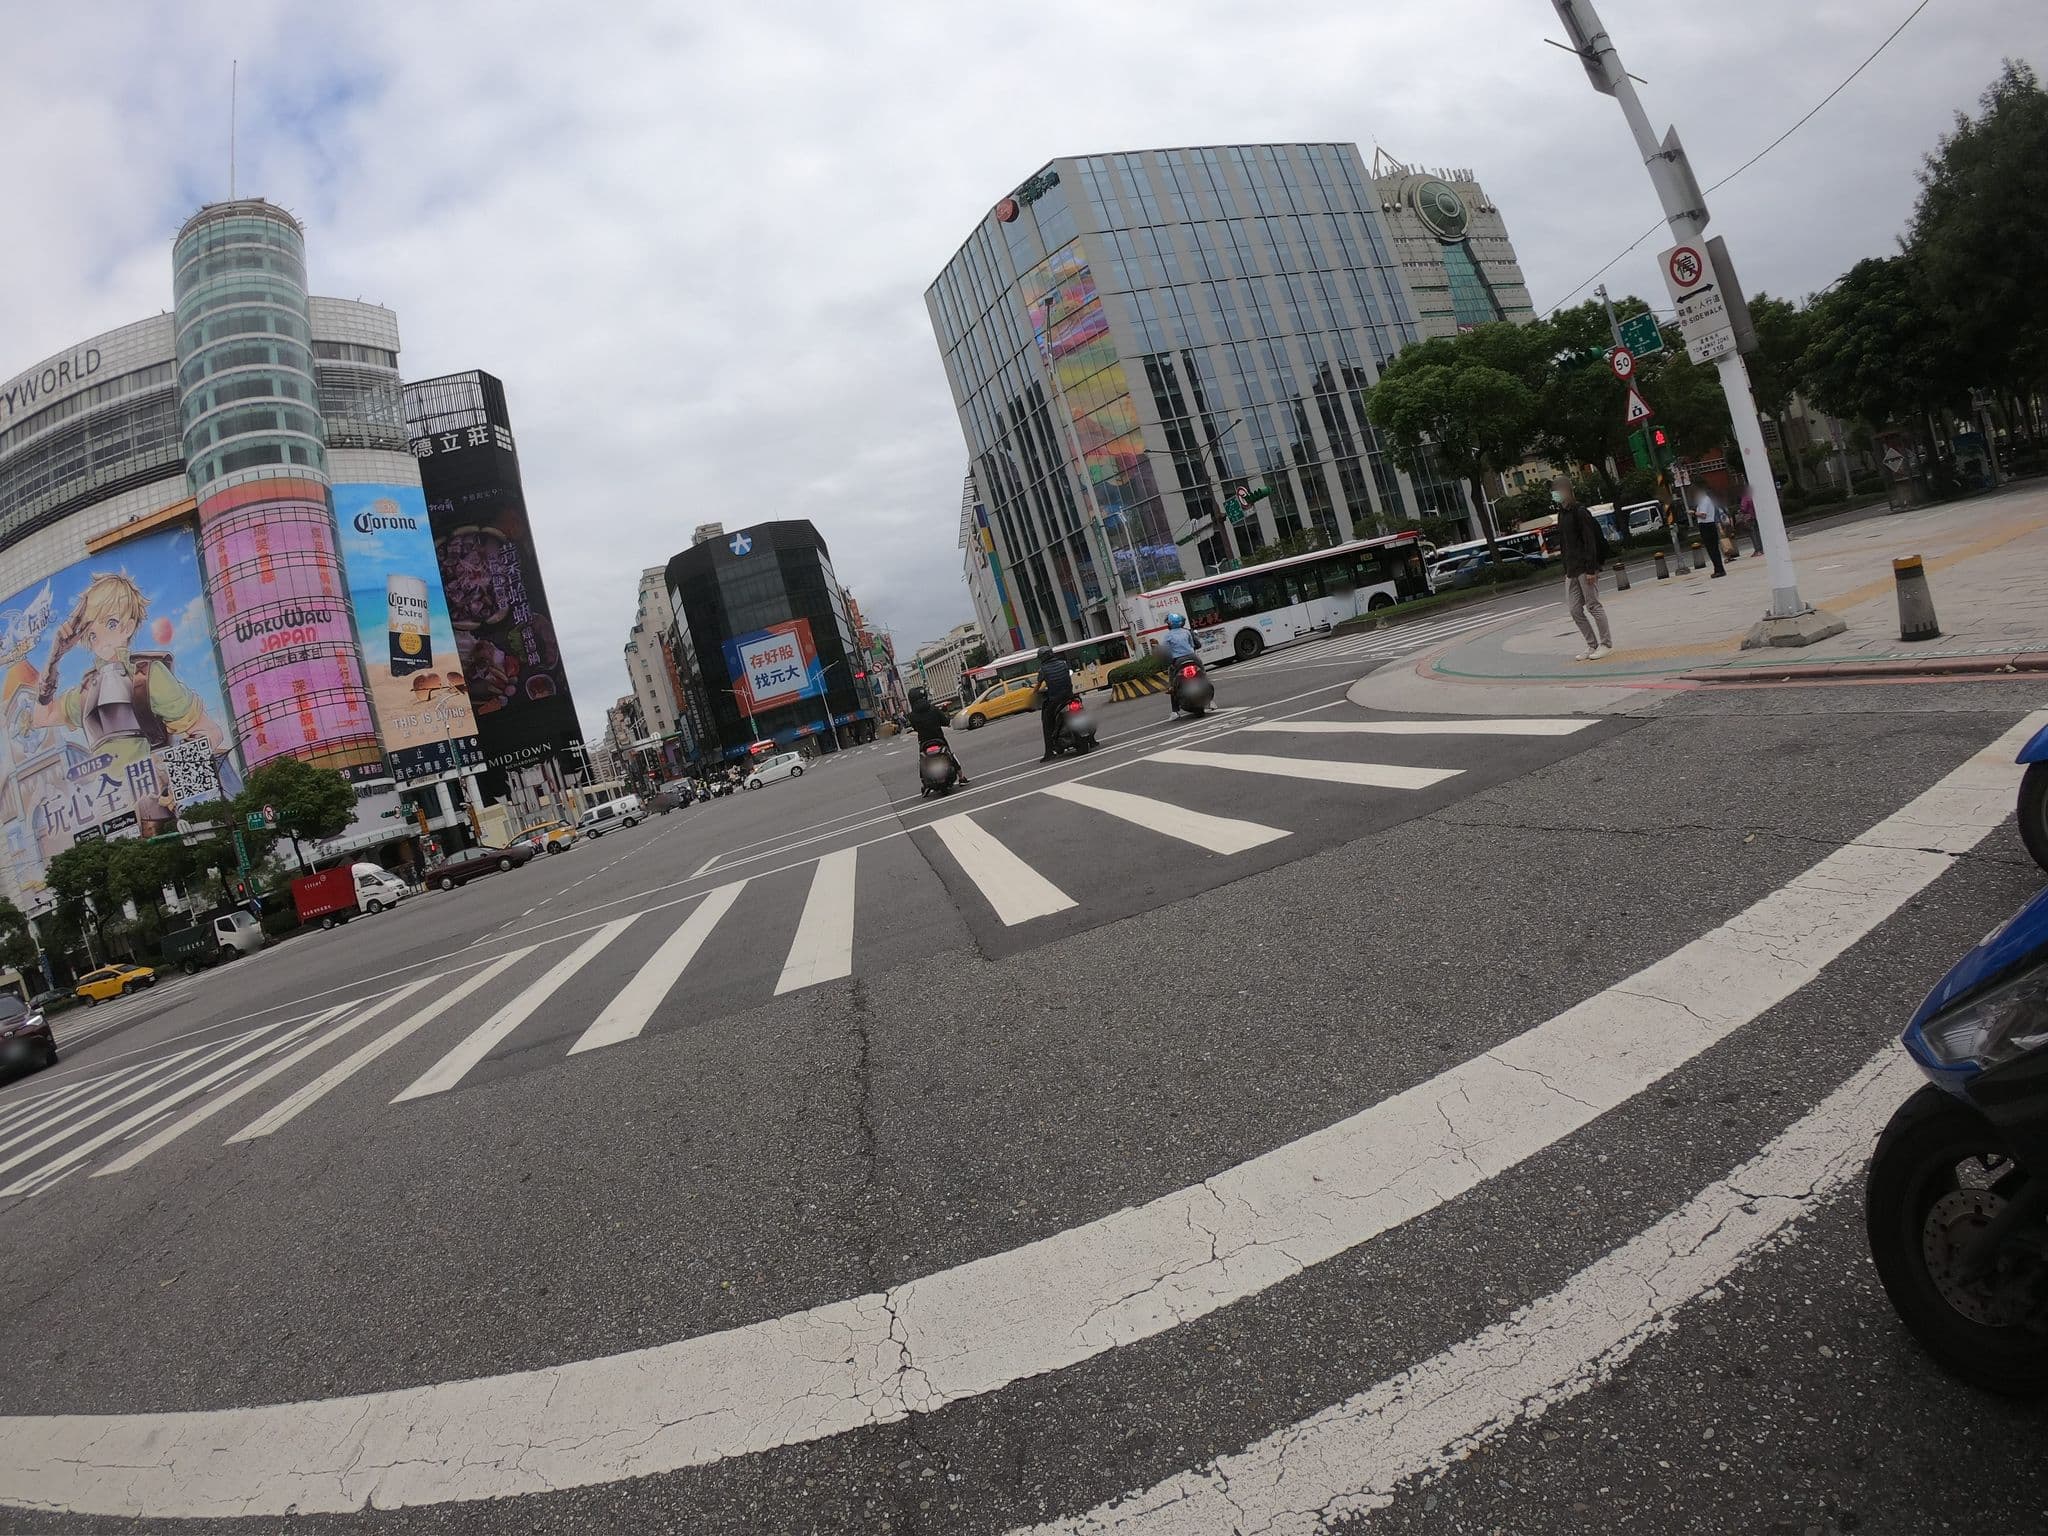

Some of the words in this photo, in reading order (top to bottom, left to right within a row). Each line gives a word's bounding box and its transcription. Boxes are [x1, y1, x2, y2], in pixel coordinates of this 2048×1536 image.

[1688, 305, 1724, 324] SIDEWALK
[1616, 357, 1630, 371] 50
[411, 425, 489, 458] 德立莊
[353, 513, 417, 535] Corona
[388, 592, 428, 609] Corona
[397, 606, 423, 619] Extra
[749, 644, 795, 669] 存好股
[755, 664, 801, 690] 找元大
[393, 715, 418, 729] THIS
[422, 712, 433, 724] IS
[435, 706, 466, 722] LIVING
[488, 742, 552, 769] MIDTOWN
[76, 760, 104, 776] 10/15
[42, 757, 160, 836] 玩心全開
